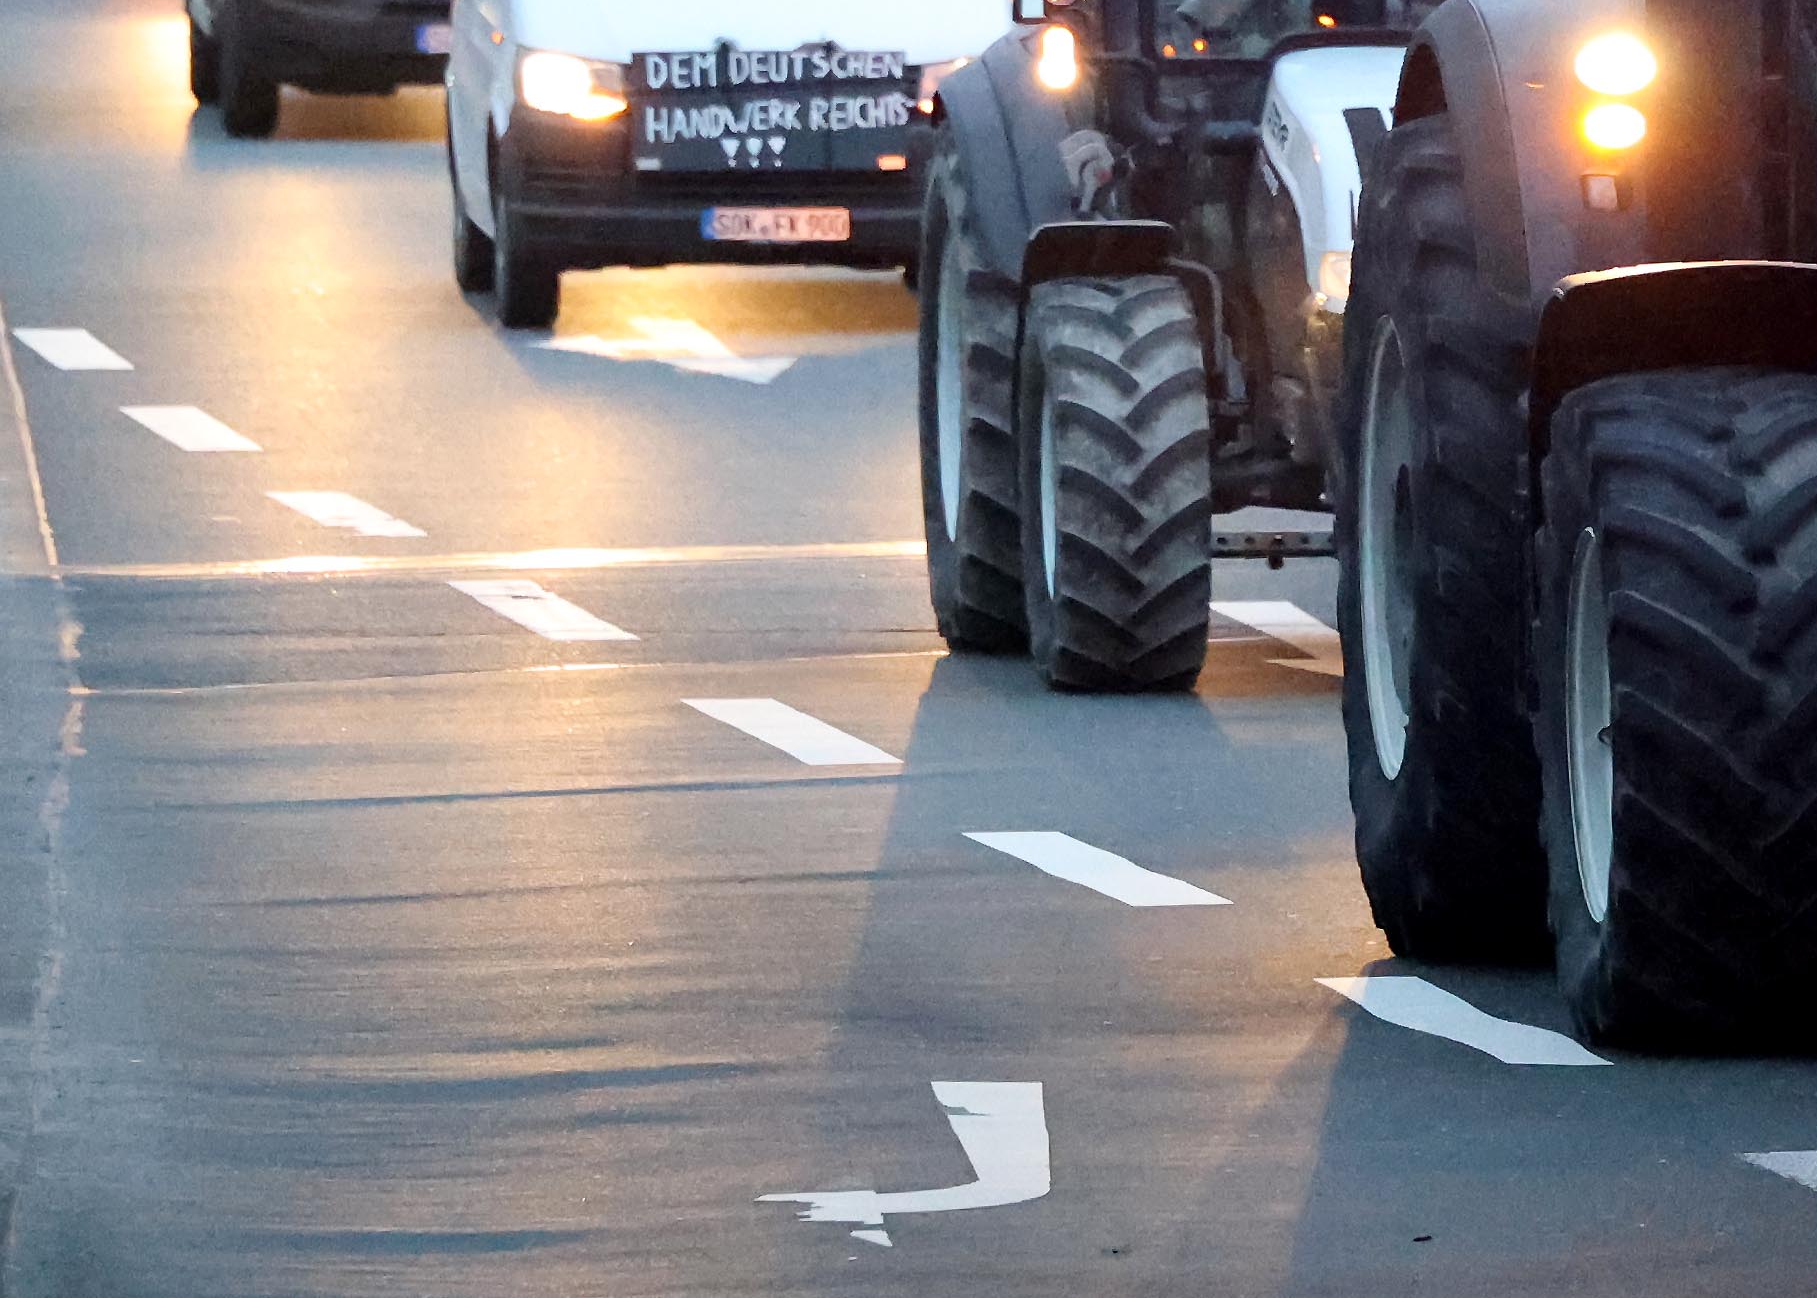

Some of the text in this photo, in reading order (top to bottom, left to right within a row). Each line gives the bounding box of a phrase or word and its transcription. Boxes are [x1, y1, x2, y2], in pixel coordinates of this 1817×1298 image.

[645, 51, 904, 90] DEM DEUTSCHEN
[645, 99, 802, 144] HANDWERK
